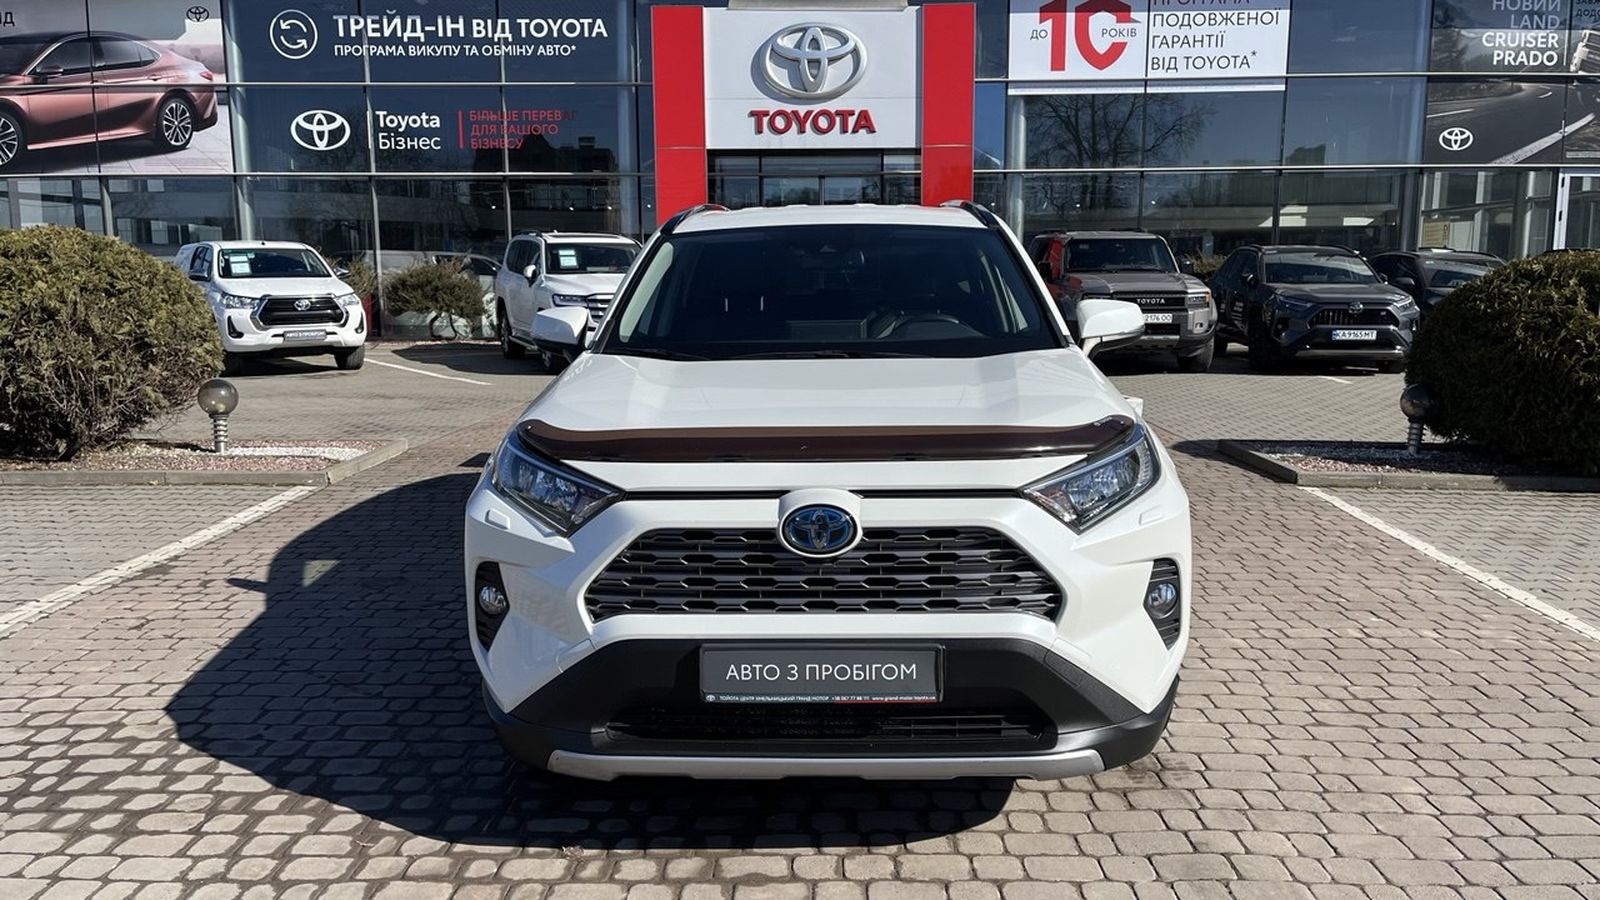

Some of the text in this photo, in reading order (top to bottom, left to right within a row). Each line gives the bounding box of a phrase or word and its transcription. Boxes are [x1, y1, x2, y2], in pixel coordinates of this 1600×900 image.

[333, 10, 608, 41] ТРЕЙД-ІН ВІД TOYOTA
[1152, 8, 1280, 29] ПОДОВЖЕНОЇ
[1510, 14, 1560, 29] LAND
[1030, 29, 1048, 41] ДО
[1101, 27, 1137, 39] РОКІВ
[1151, 31, 1226, 49] ГАРАНТІЇ
[1482, 32, 1559, 48] CRUISER
[335, 44, 405, 57] ПРОГРАМА
[408, 45, 461, 57] ВИКУПУ
[463, 45, 479, 57] ТА
[481, 45, 535, 57] ОБМІНУ
[1493, 51, 1557, 66] PRADO
[1150, 56, 1178, 72] ВІД
[376, 110, 441, 133] Toyota
[469, 110, 519, 121] БІЛЬШЕ
[749, 109, 876, 135] TOYOTA
[471, 124, 558, 136] ДЛЯ ВАШОГО
[378, 132, 441, 150] Бізнес
[471, 138, 524, 149] БІЗНЕСУ
[726, 663, 917, 681] АВТО З ПРОБІГОМ
